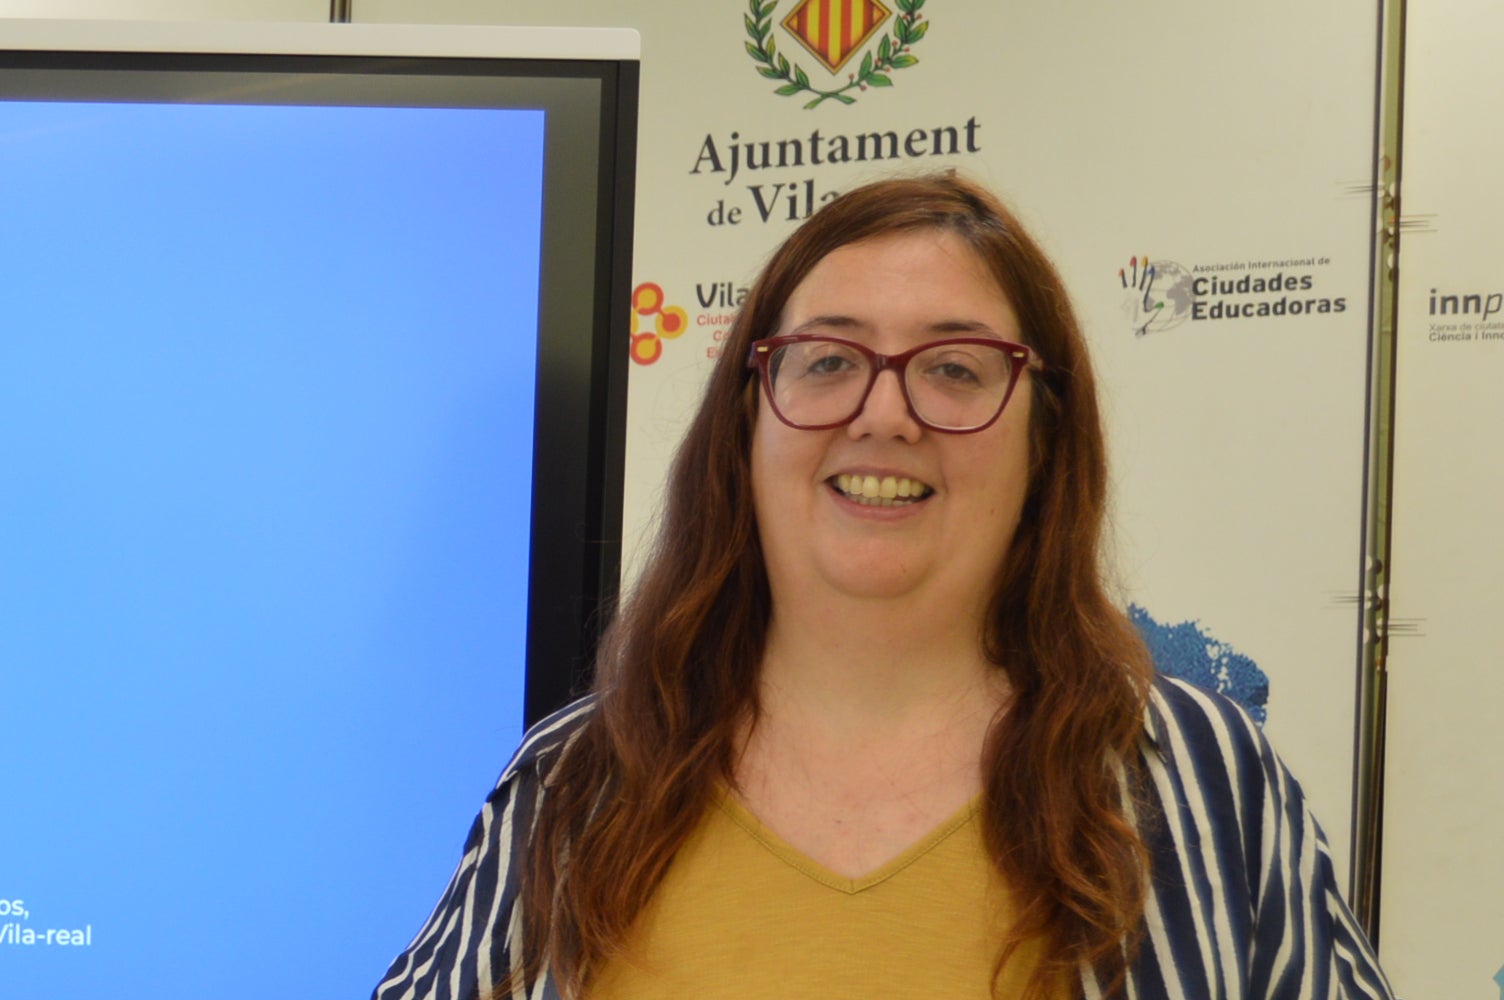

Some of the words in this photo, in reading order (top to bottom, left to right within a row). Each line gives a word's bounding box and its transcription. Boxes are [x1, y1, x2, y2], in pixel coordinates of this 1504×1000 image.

[689, 116, 982, 186] Ajuntament
[706, 200, 743, 226] de
[1193, 263, 1246, 273] Asociación
[1248, 257, 1315, 270] Internacional
[1318, 257, 1331, 265] de
[1192, 272, 1313, 297] Ciudades
[1192, 297, 1347, 321] Educadoras
